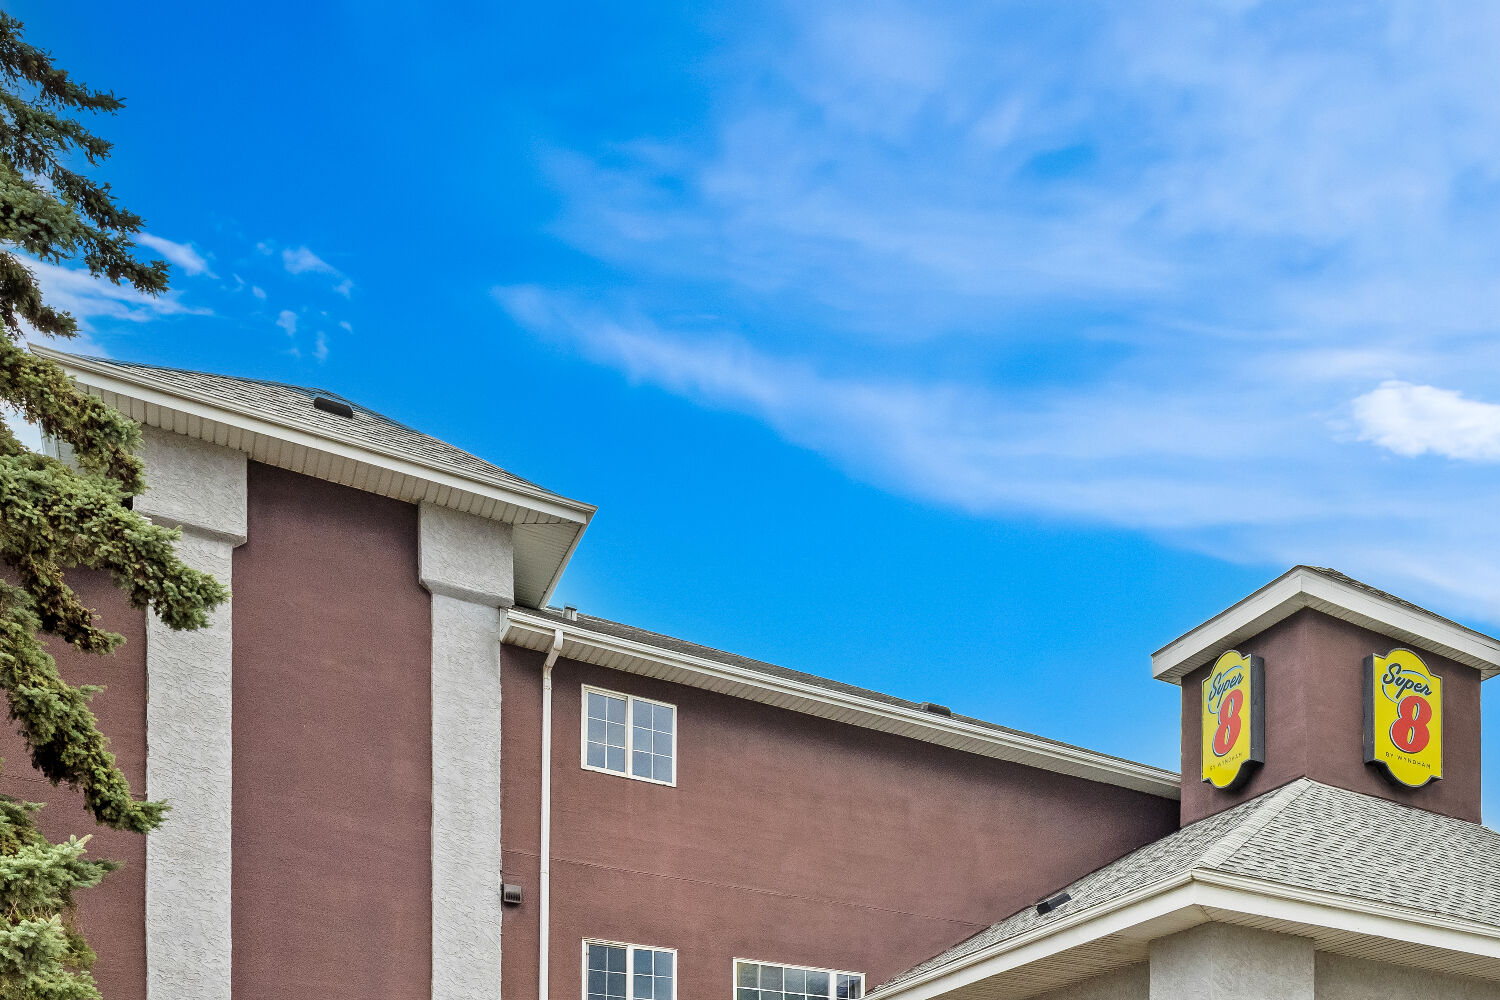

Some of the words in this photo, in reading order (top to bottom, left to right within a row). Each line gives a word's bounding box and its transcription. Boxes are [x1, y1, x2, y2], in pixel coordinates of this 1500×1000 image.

[1208, 672, 1244, 710] Super
[1382, 662, 1432, 700] Super
[1212, 688, 1243, 757] 8
[1389, 695, 1432, 754] 8
